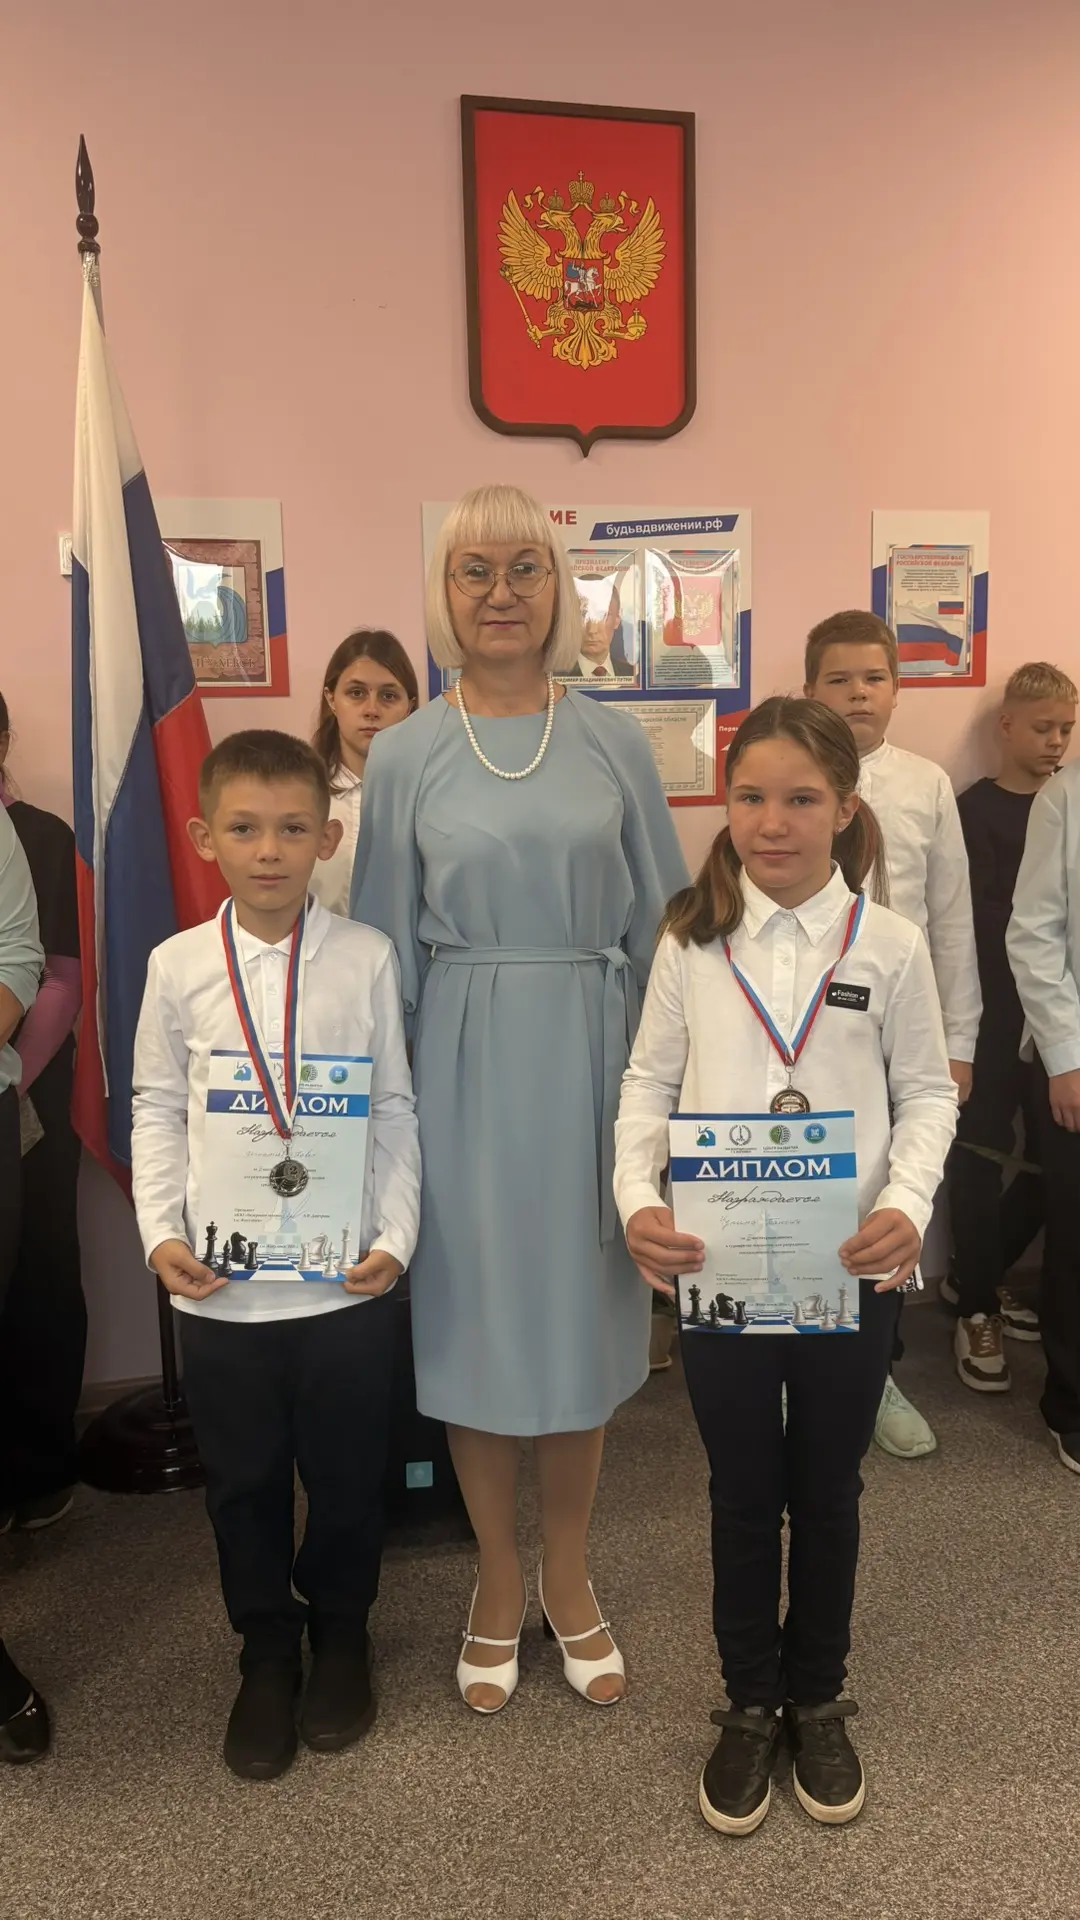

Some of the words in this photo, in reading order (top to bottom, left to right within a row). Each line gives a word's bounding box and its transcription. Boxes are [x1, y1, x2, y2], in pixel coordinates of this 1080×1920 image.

[606, 518, 723, 537] будьвдвижении.рф
[837, 989, 859, 999] Fashion
[229, 1093, 348, 1114] ДИЛОМ
[289, 1165, 298, 1175] 2
[696, 1157, 831, 1179] ДИПЛОМ
